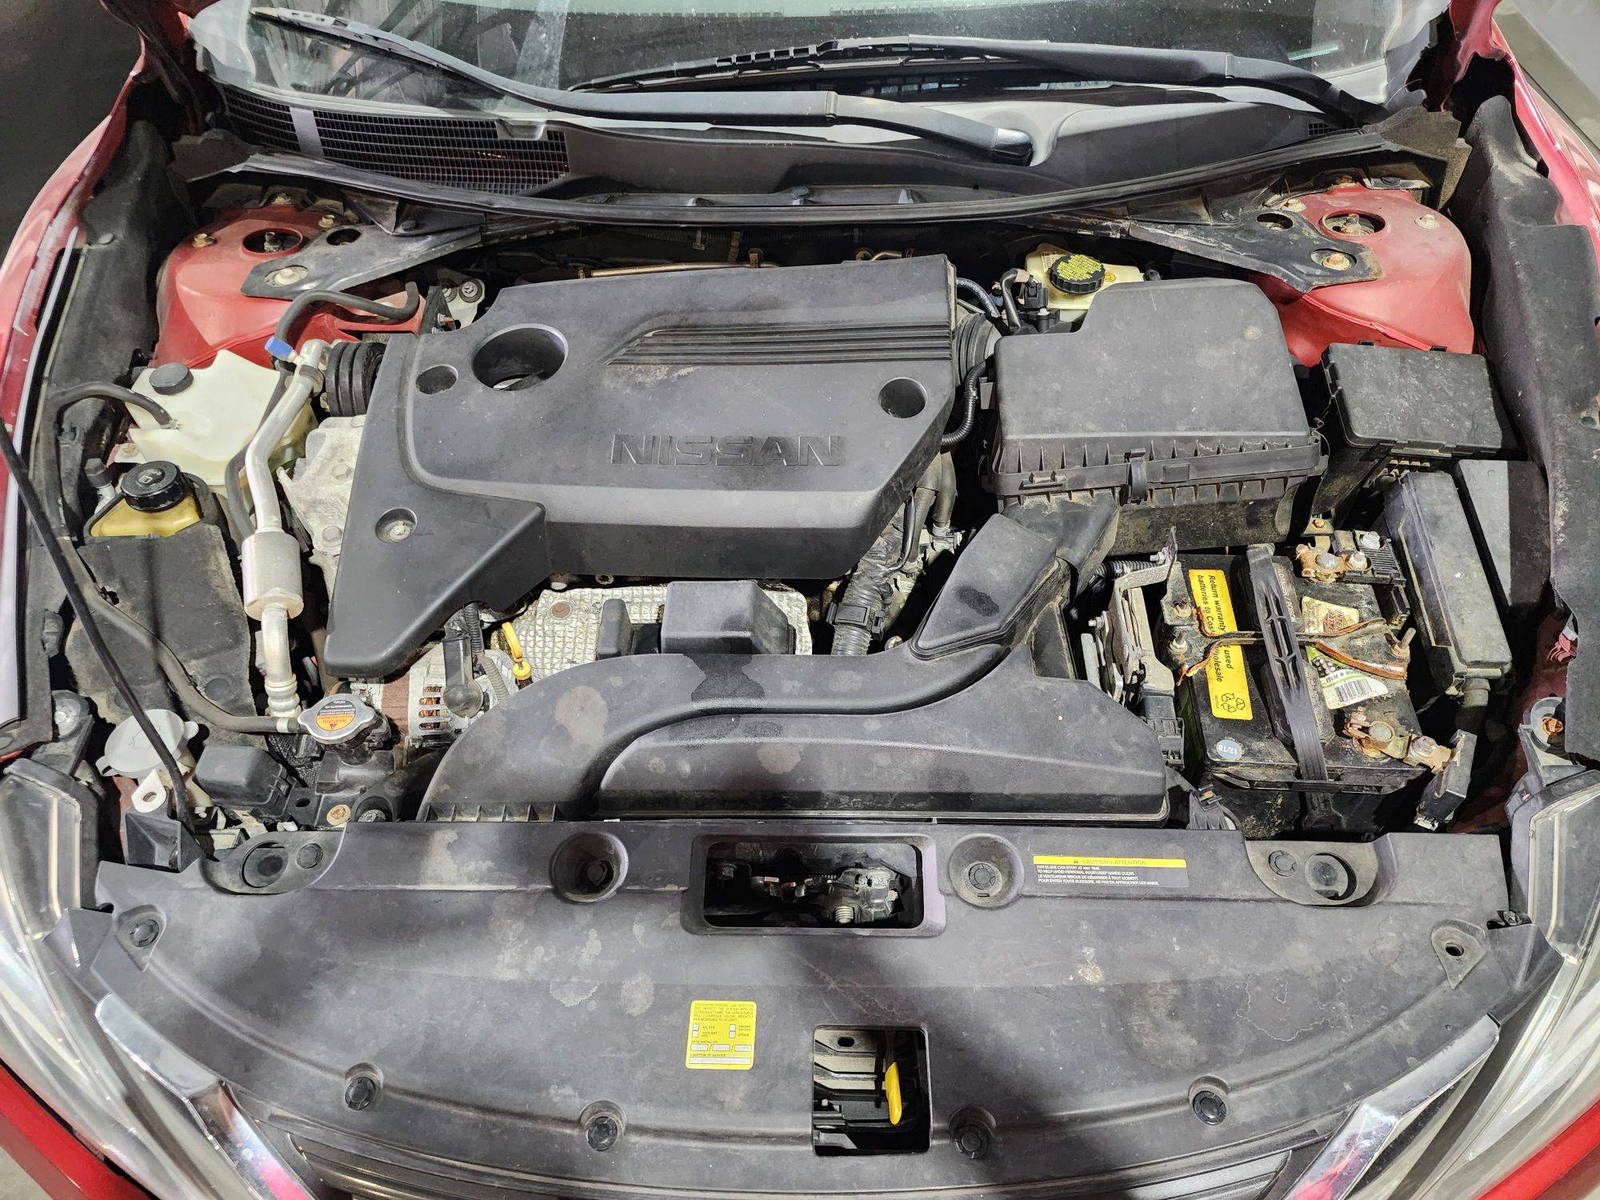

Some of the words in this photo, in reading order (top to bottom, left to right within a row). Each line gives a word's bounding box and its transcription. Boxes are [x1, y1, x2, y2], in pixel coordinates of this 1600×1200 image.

[610, 434, 841, 467] NISSAN
[1197, 574, 1208, 606] batteries
[1209, 574, 1218, 598] Return
[1214, 598, 1226, 631] warranty
[1225, 648, 1234, 670] used
